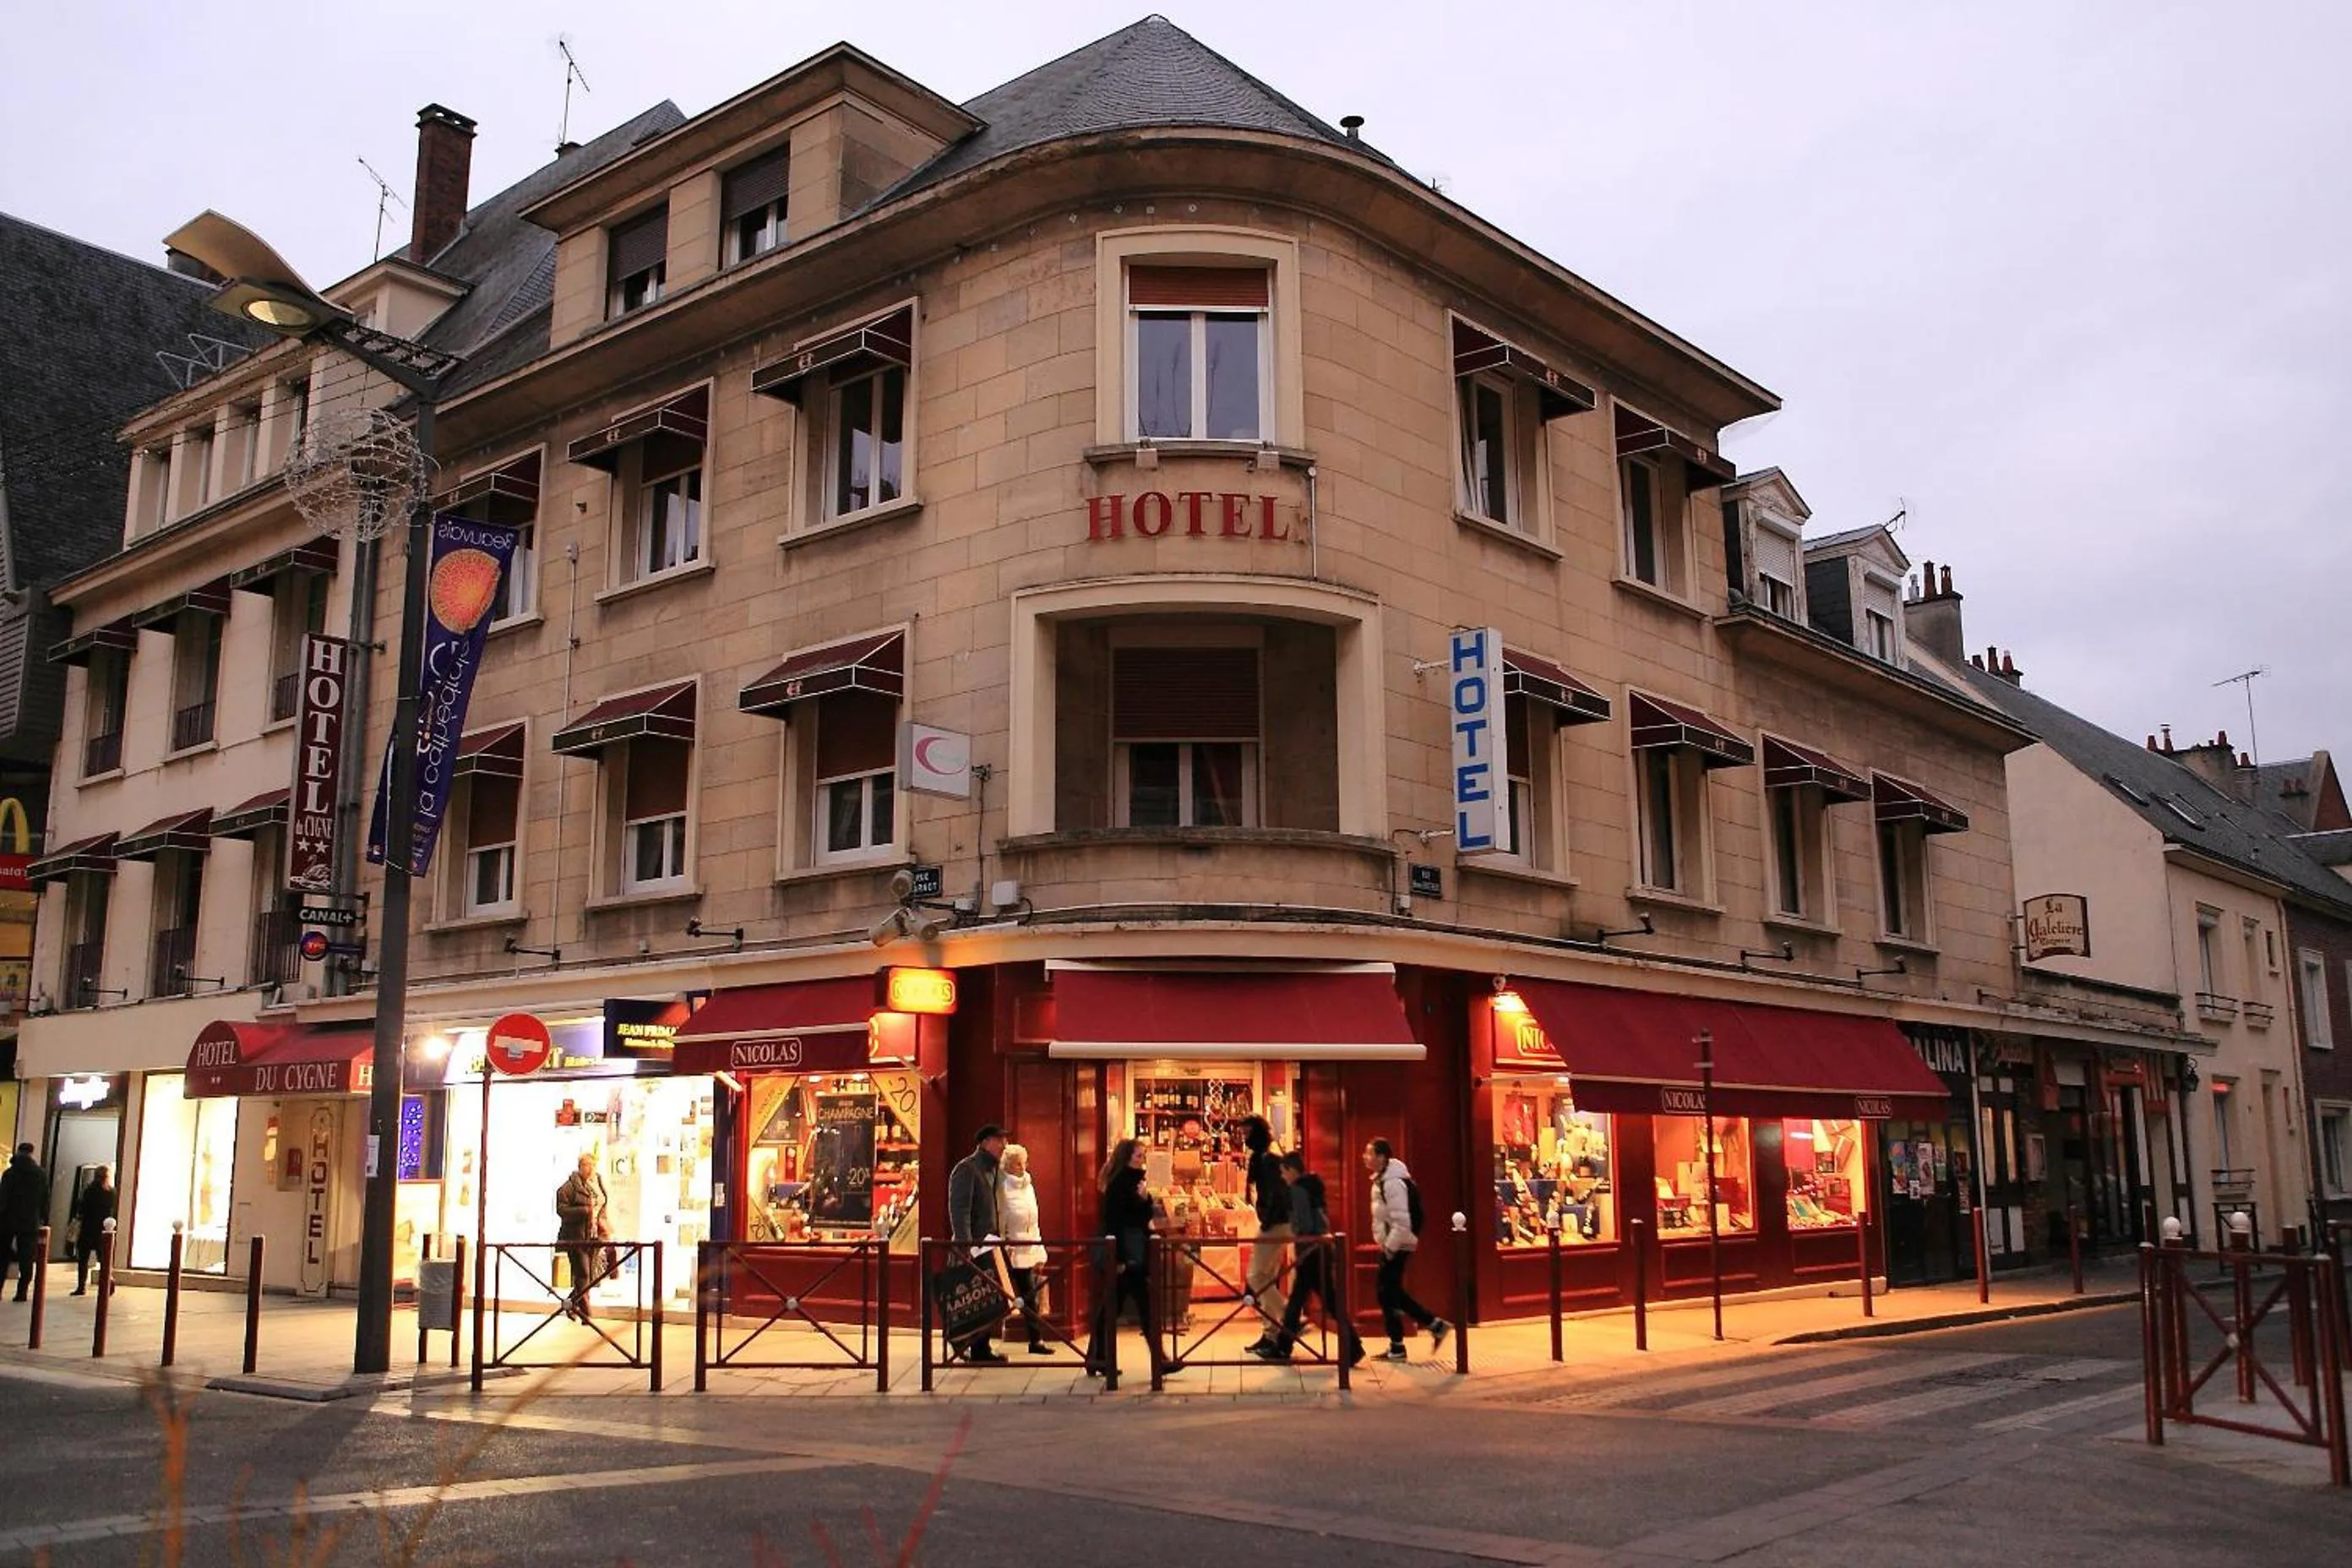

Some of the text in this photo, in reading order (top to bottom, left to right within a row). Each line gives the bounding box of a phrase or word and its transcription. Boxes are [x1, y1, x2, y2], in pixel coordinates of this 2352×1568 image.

[1086, 492, 1289, 542] HOTEL
[302, 639, 346, 814] HOTEL
[1452, 632, 1491, 848] HOTEL
[299, 908, 354, 924] CANAL+
[2044, 897, 2063, 914] La
[197, 1040, 237, 1066] HOTEL
[734, 1042, 798, 1064] NICOLAS
[255, 1066, 277, 1092] DU
[285, 1063, 338, 1091] CYGNE
[1663, 1091, 1707, 1109] NICOLA
[1858, 1098, 1891, 1116] NICOLAS
[817, 1106, 875, 1120] CHAMPAGNE
[307, 1130, 329, 1265] HOTEL
